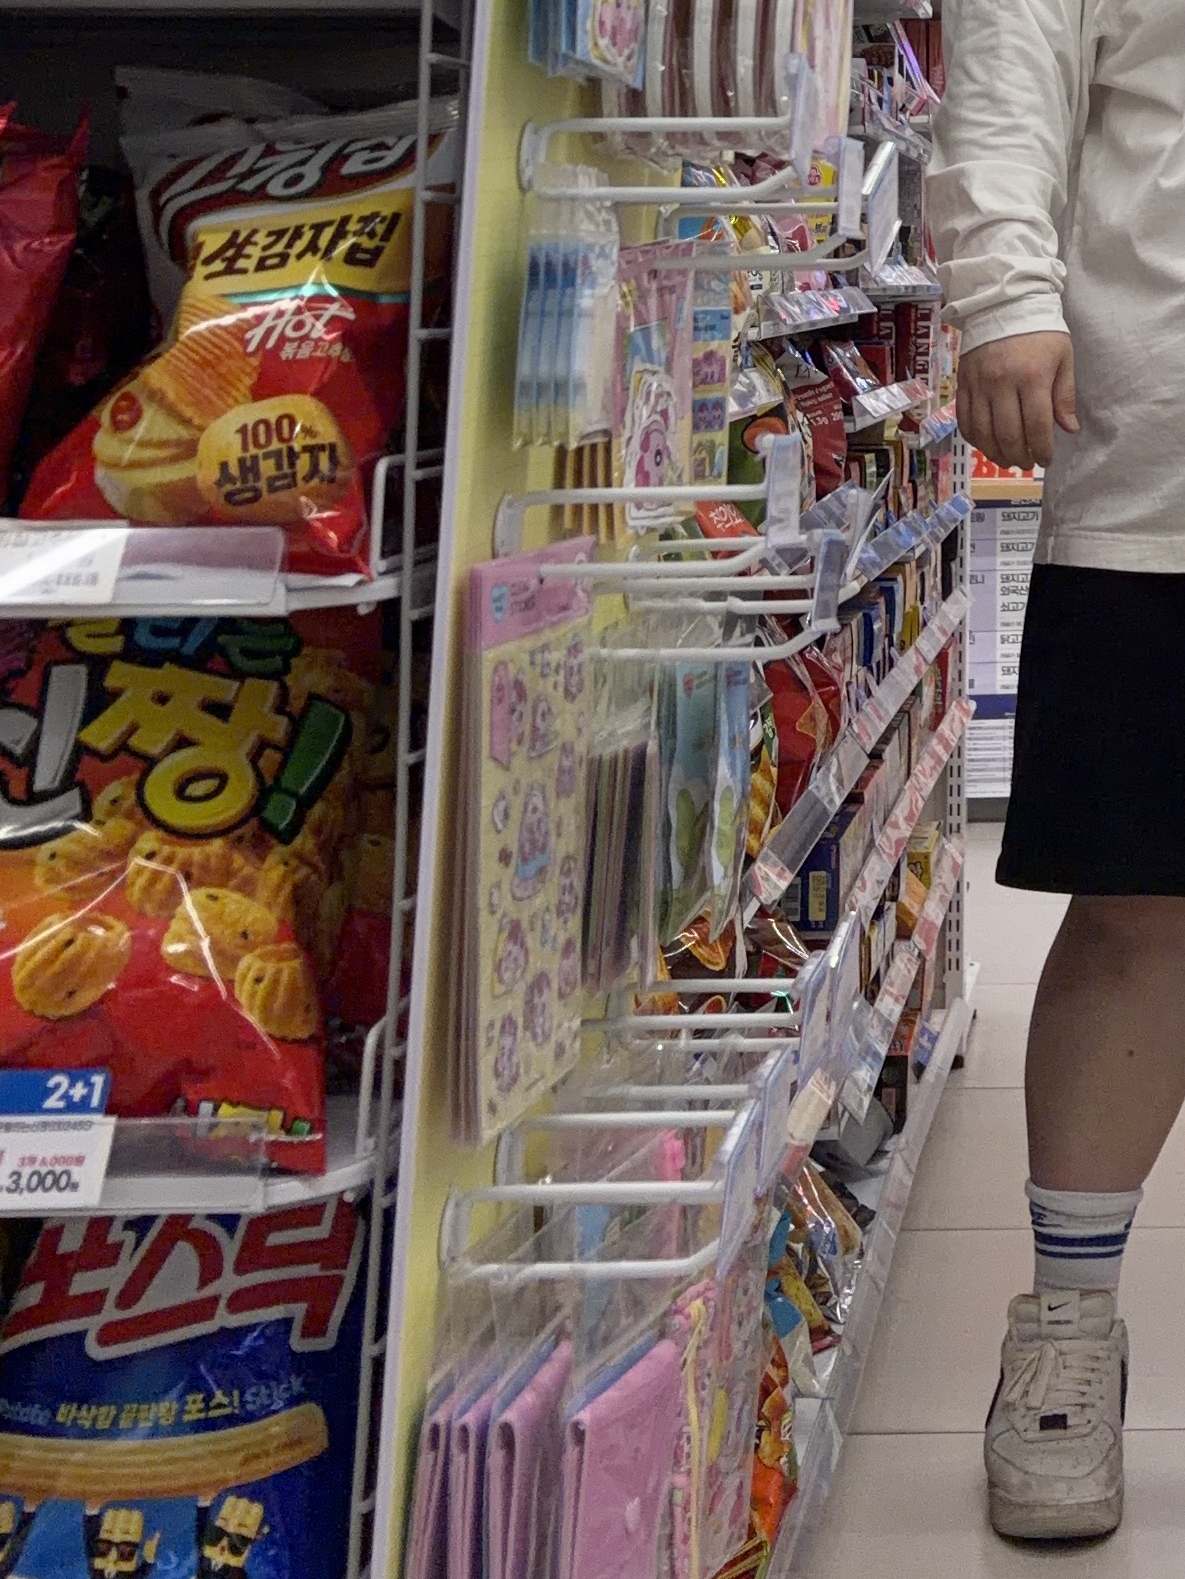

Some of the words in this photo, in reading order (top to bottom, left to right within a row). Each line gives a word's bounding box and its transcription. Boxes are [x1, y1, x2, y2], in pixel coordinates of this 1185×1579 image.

[245, 298, 356, 354] Hot
[235, 412, 319, 454] 100%
[214, 441, 341, 508] 생감자
[42, 1072, 106, 1110] 2+1
[0, 1198, 353, 1342] 포스틱
